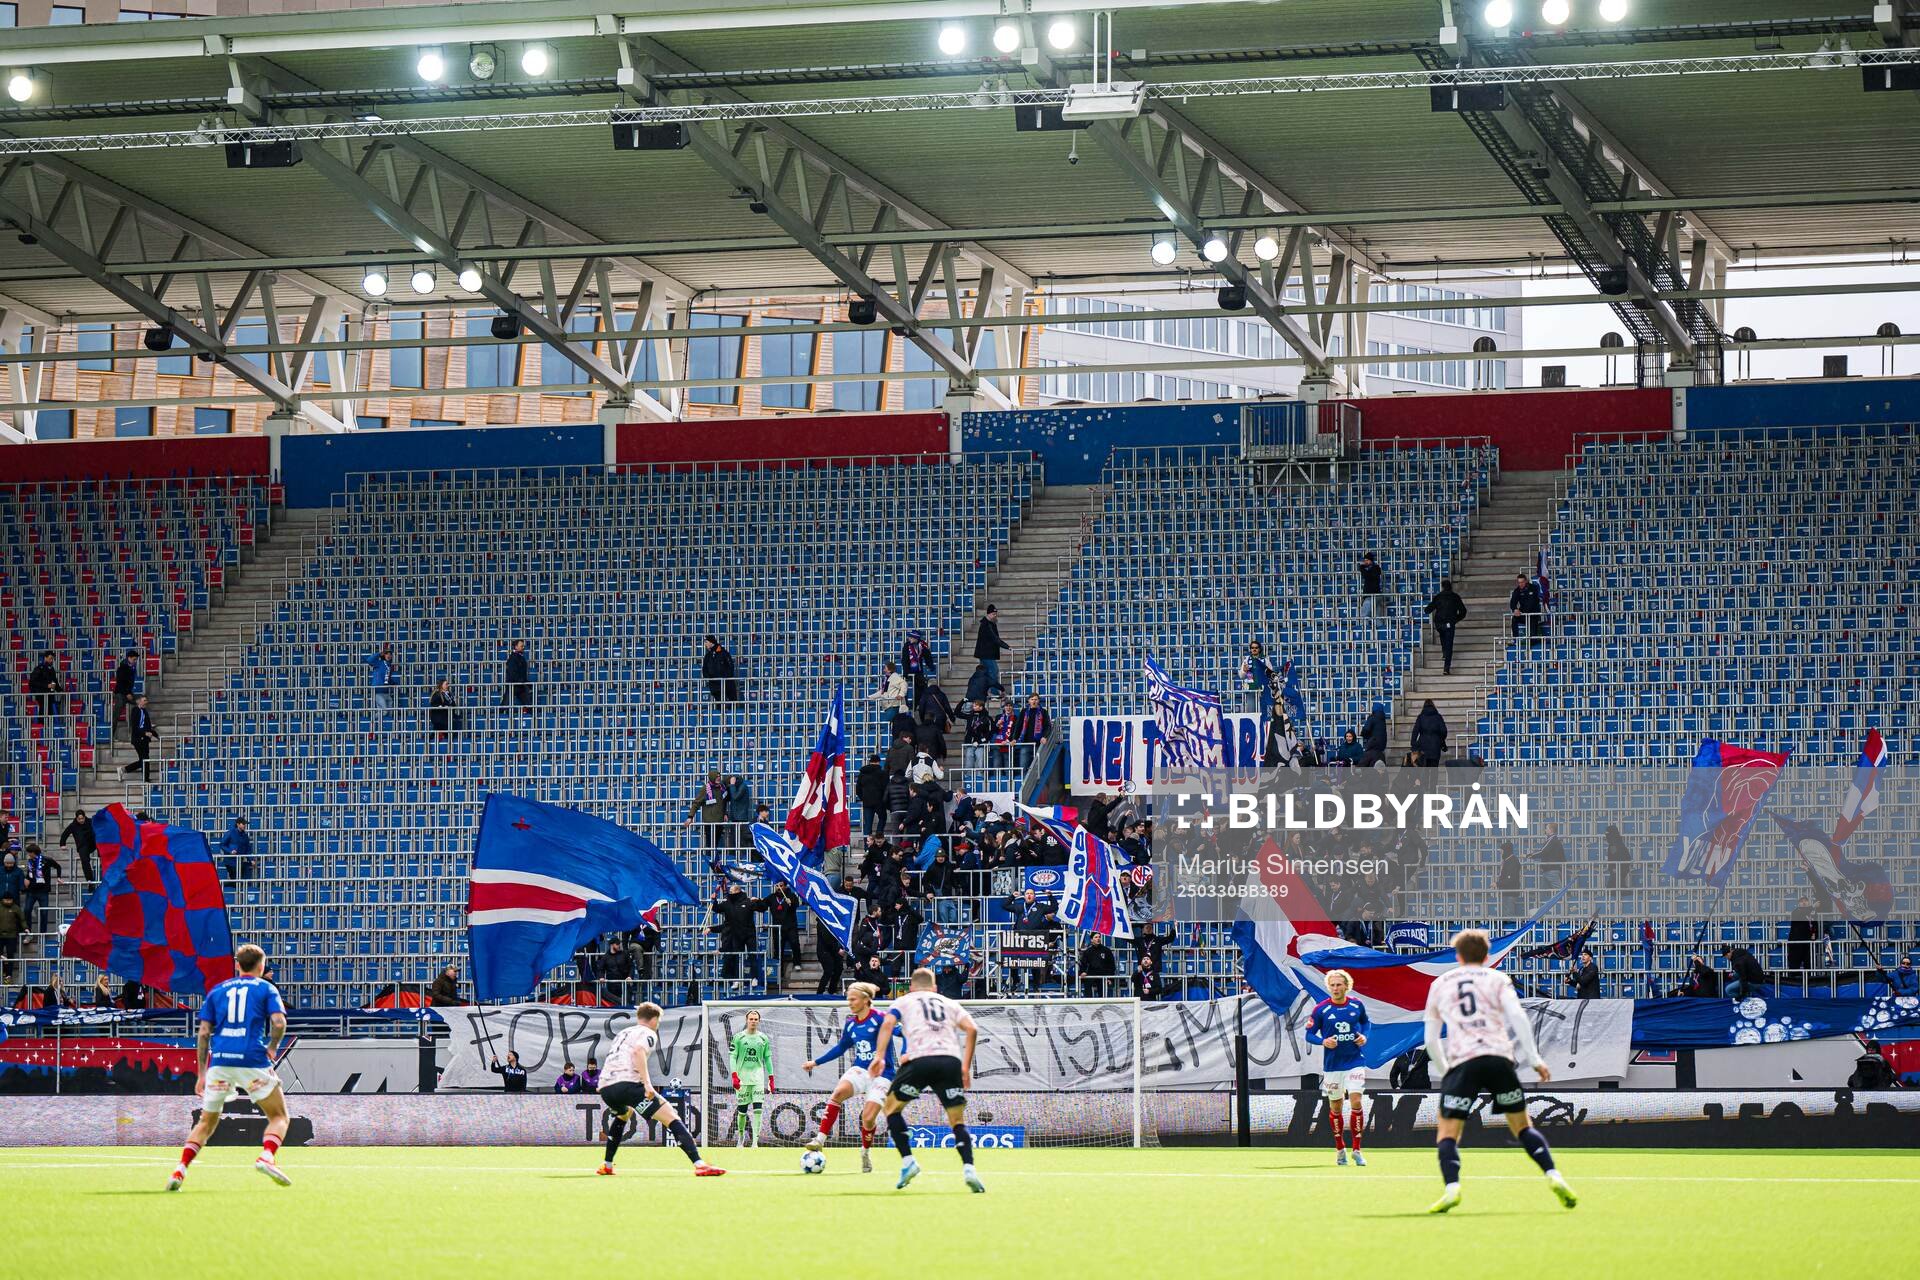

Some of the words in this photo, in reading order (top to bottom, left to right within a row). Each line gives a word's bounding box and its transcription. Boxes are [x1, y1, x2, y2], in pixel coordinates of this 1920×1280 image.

[1082, 718, 1133, 786] NEI
[1002, 930, 1048, 950] Ultras,
[1008, 957, 1046, 968] kriminelle
[226, 986, 248, 1023] 11
[918, 997, 945, 1022] 10
[1457, 979, 1476, 1017] 5
[467, 1008, 748, 1079] FORSVA
